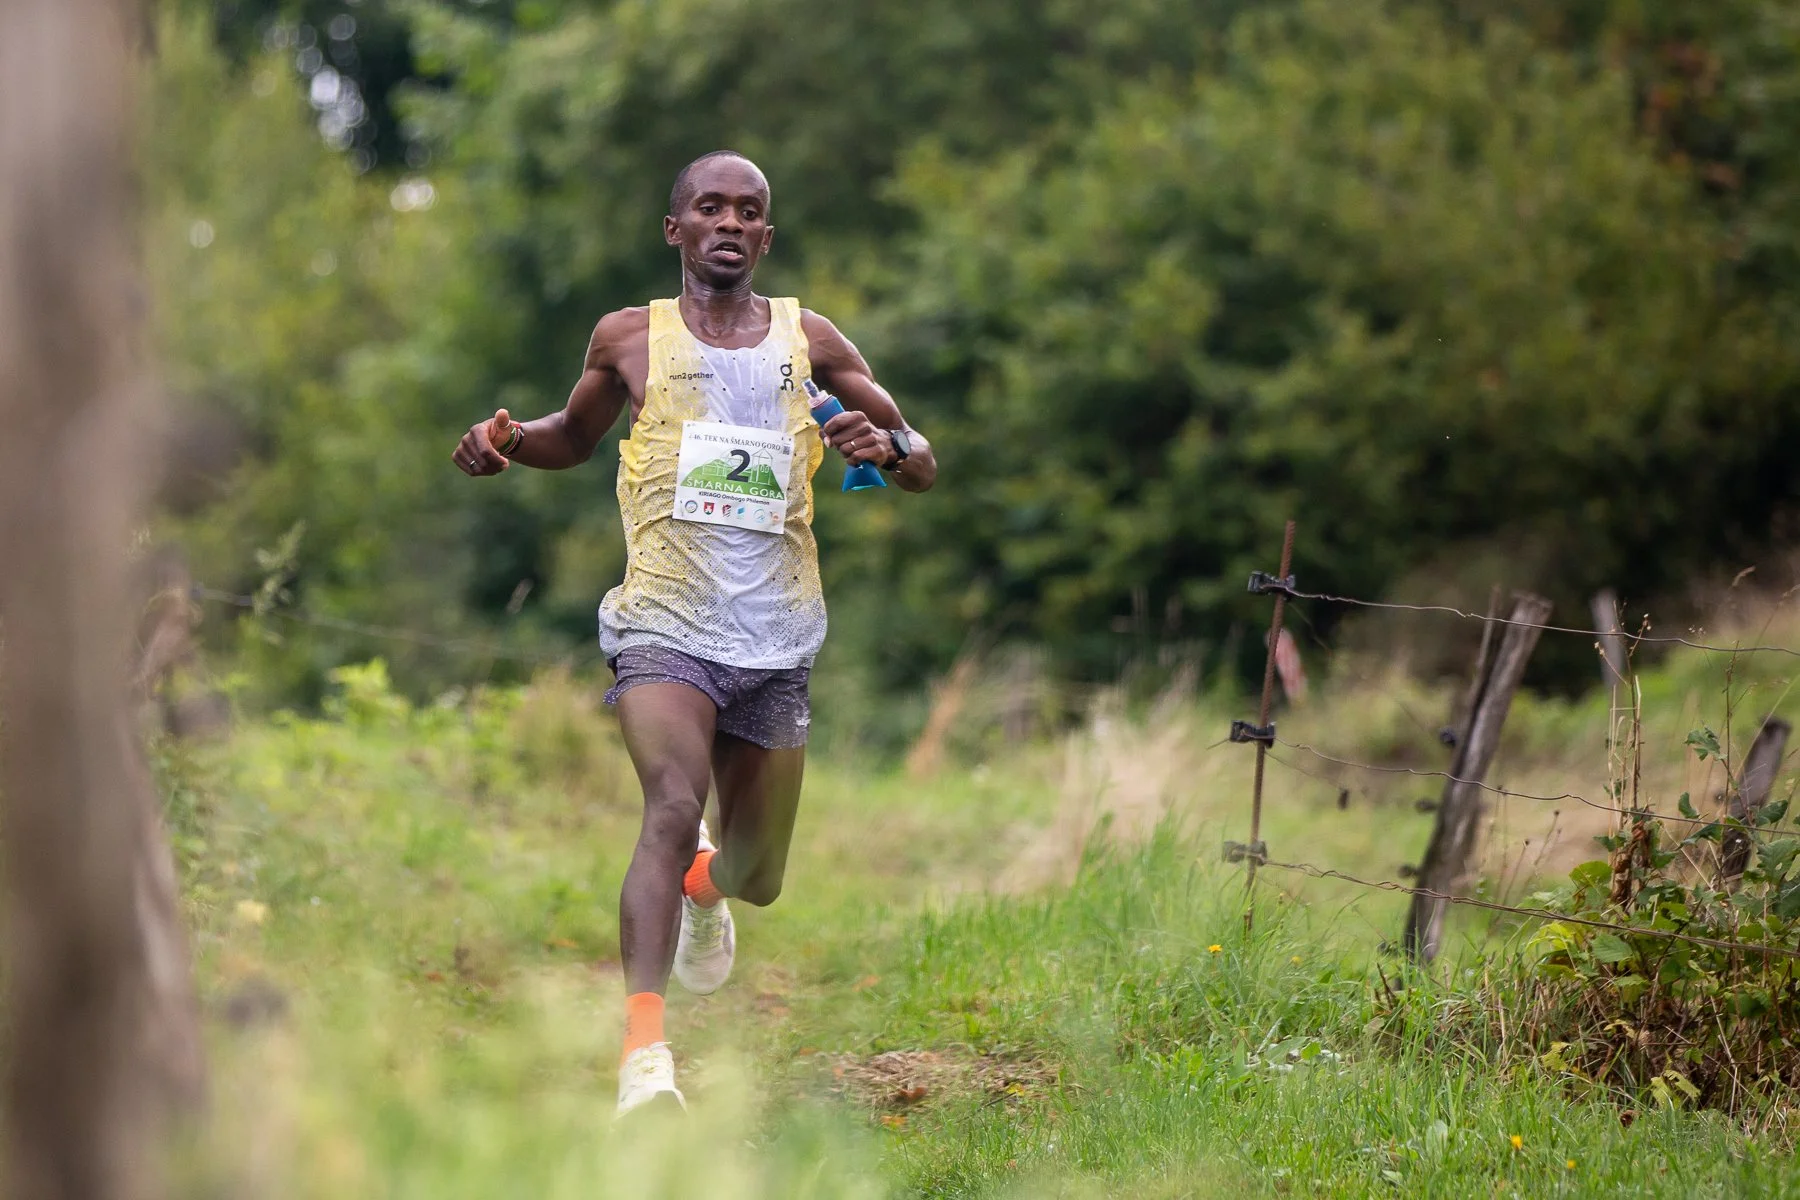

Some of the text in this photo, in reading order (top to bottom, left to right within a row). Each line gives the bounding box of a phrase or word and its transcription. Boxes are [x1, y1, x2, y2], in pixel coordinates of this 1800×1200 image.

[669, 371, 714, 380] run2gether
[704, 434, 718, 442] TEK
[730, 436, 761, 448] ŠMARNO
[761, 442, 781, 451] GORO
[726, 449, 751, 482] 2
[686, 478, 784, 499] ŠMARNA GORA
